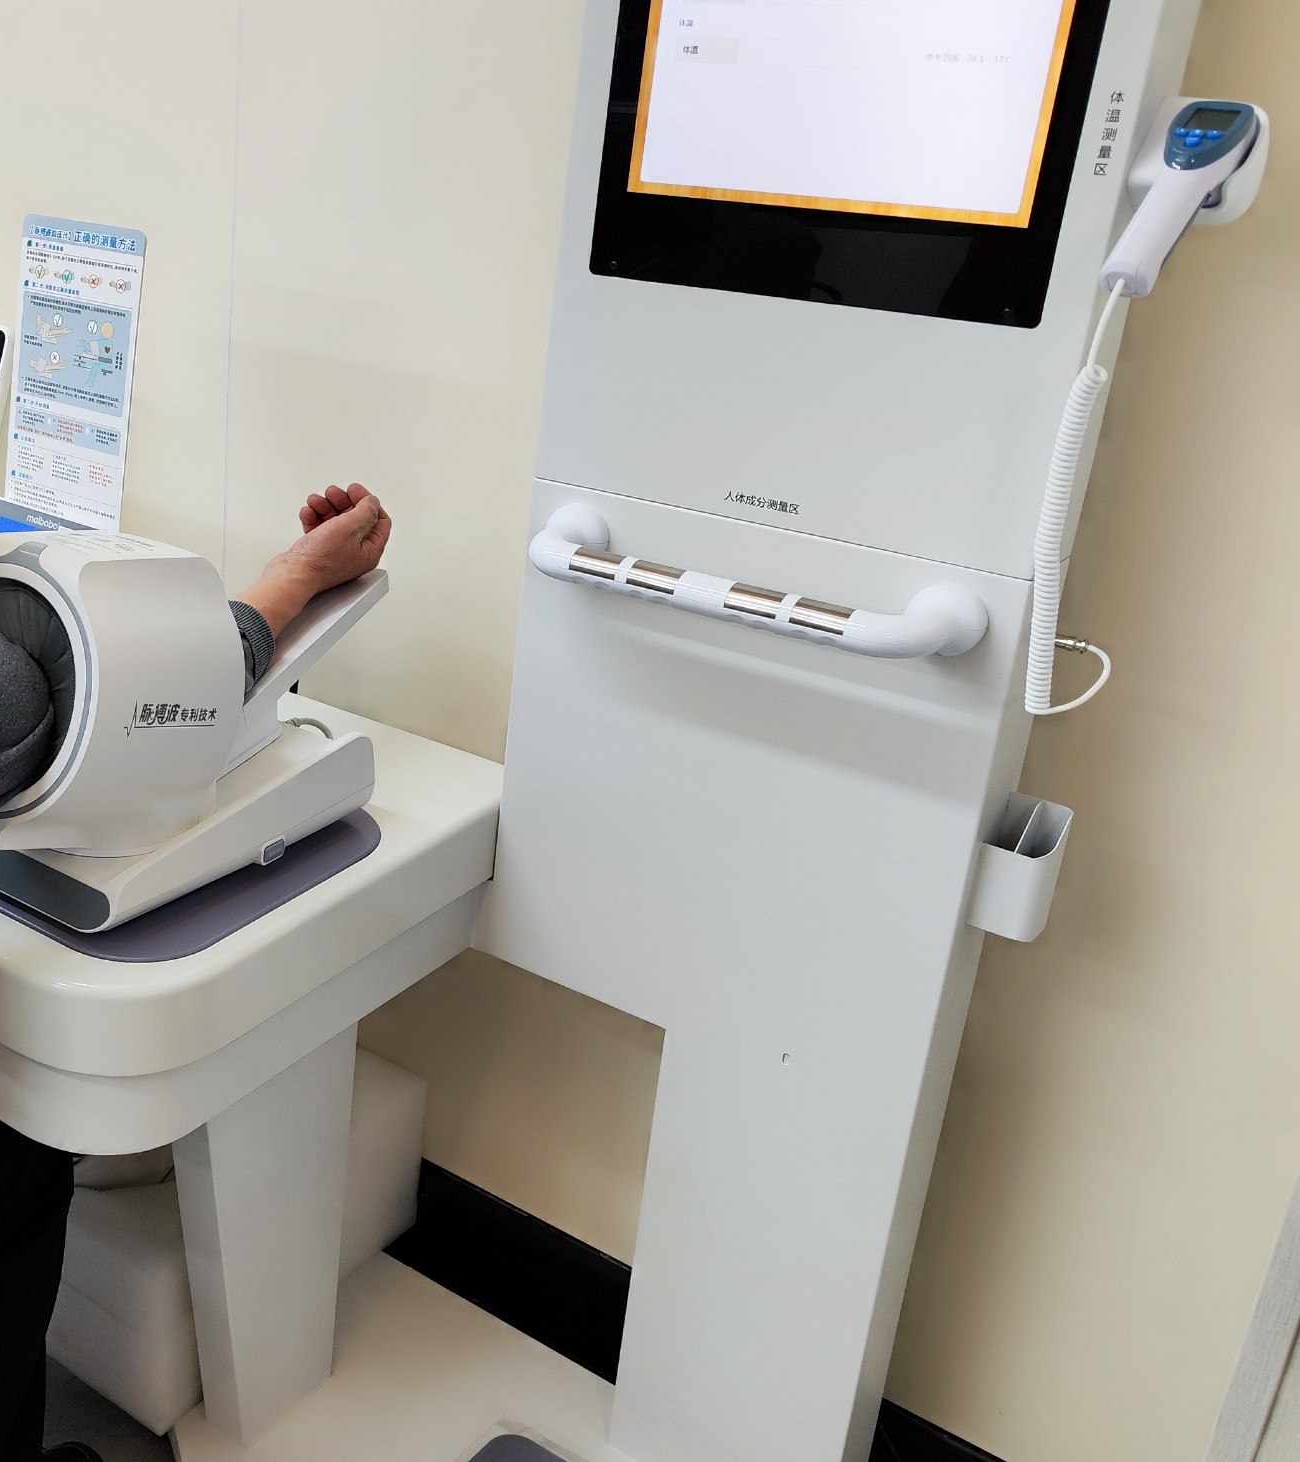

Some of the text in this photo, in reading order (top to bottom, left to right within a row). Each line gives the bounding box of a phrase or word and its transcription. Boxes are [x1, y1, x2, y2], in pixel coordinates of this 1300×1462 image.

[683, 45, 698, 54] 体温
[1094, 91, 1125, 176] 体温测量区
[724, 490, 800, 515] 人体成分测量区
[26, 514, 59, 530] maibobo
